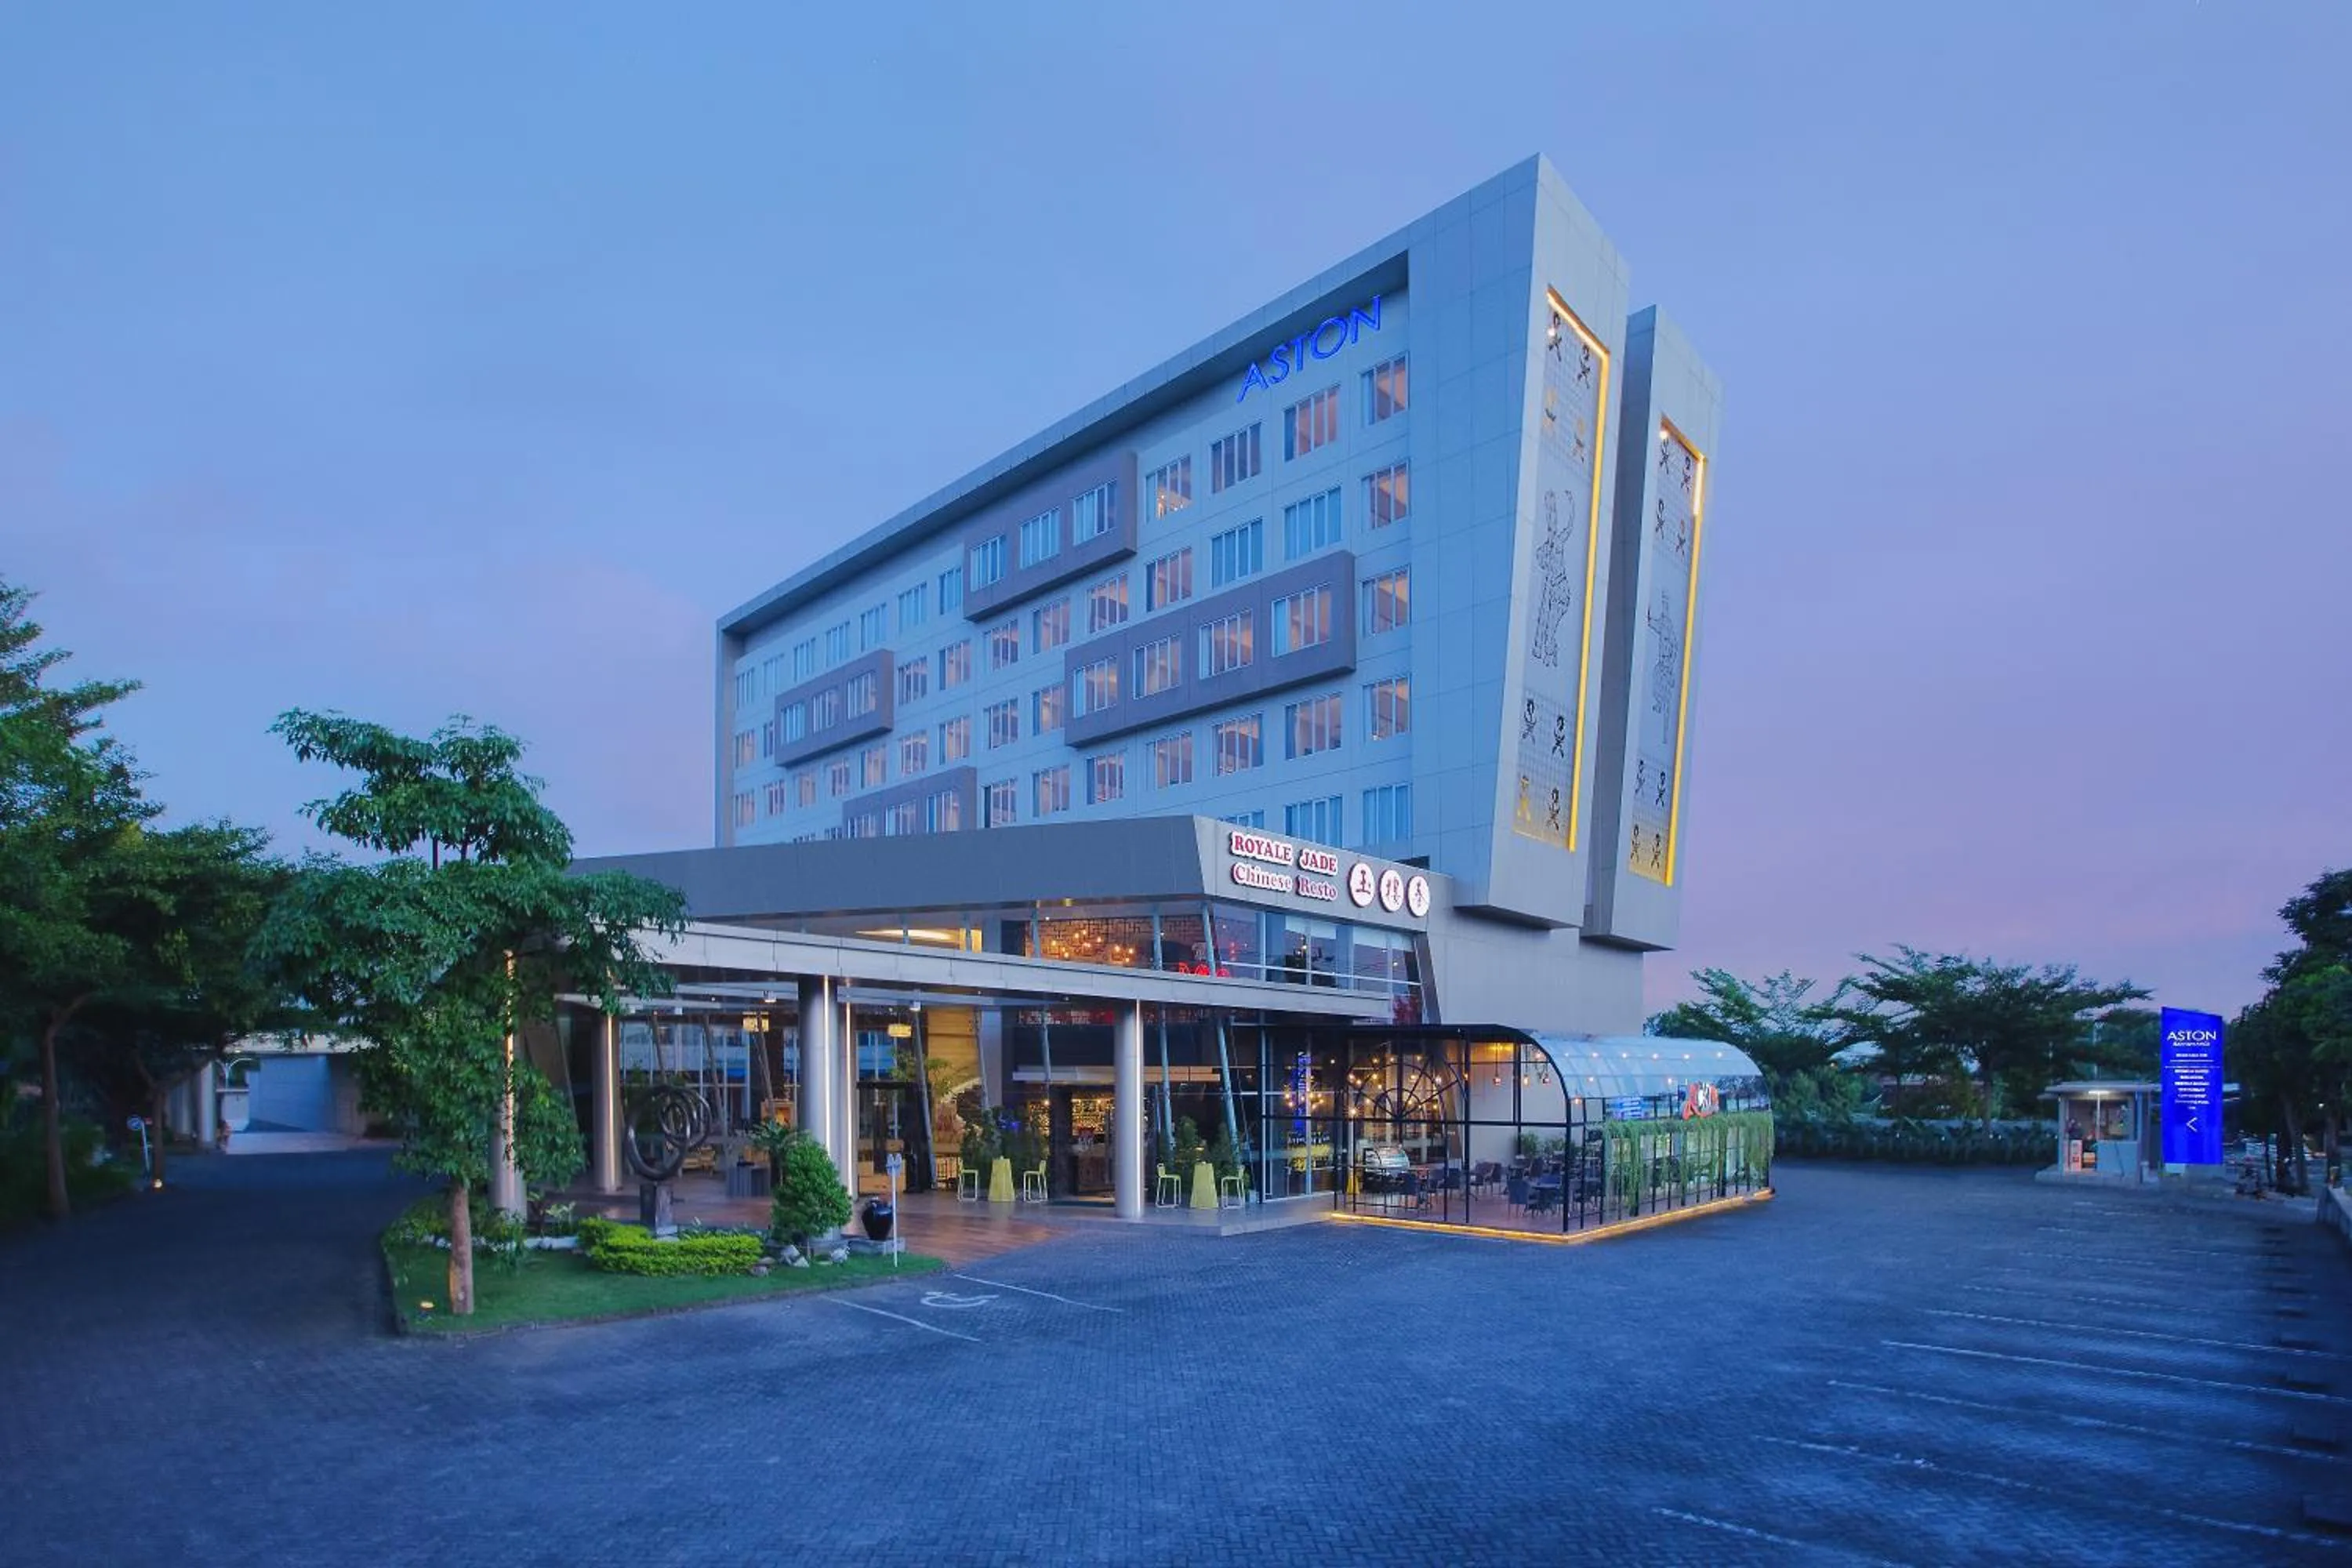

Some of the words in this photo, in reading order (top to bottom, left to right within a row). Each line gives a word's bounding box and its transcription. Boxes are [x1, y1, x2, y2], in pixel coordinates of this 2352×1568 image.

[1236, 294, 1381, 404] ASTON
[1233, 833, 1293, 863] ROYALE
[1301, 850, 1338, 873] JADE
[1234, 864, 1293, 891] Chinese
[1299, 877, 1338, 899] Resto
[2166, 1030, 2217, 1041] ASTON
